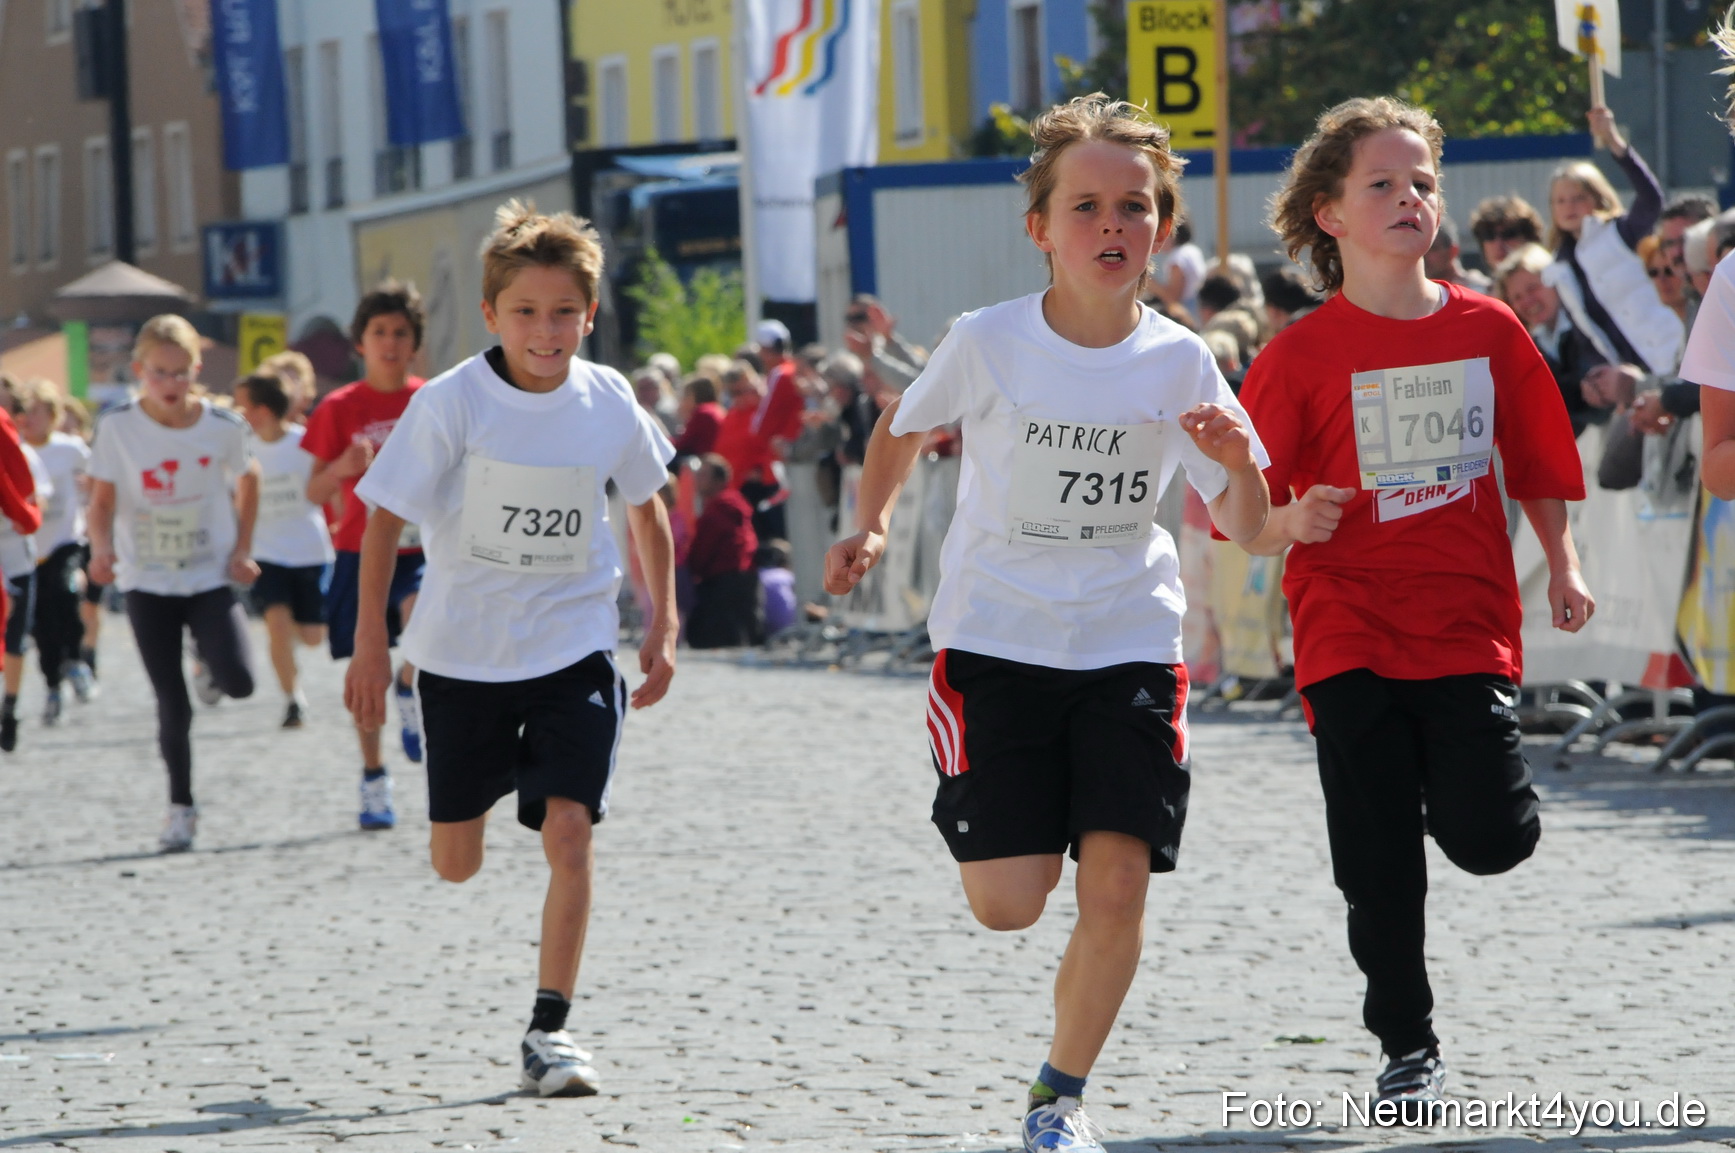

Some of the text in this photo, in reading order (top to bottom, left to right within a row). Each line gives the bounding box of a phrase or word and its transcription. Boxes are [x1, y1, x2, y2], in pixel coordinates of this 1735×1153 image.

[1140, 6, 1210, 32] Block
[1156, 46, 1201, 115] B
[1393, 375, 1453, 400] Fabian
[1361, 416, 1371, 434] K
[1398, 405, 1485, 446] 7046
[1025, 422, 1127, 456] PATRICK
[1452, 457, 1489, 475] PFLEIDERER
[1058, 470, 1149, 506] 7315
[1404, 484, 1447, 507] DEHN
[501, 505, 582, 538] 7320
[1094, 522, 1139, 535] PFLEIDERER
